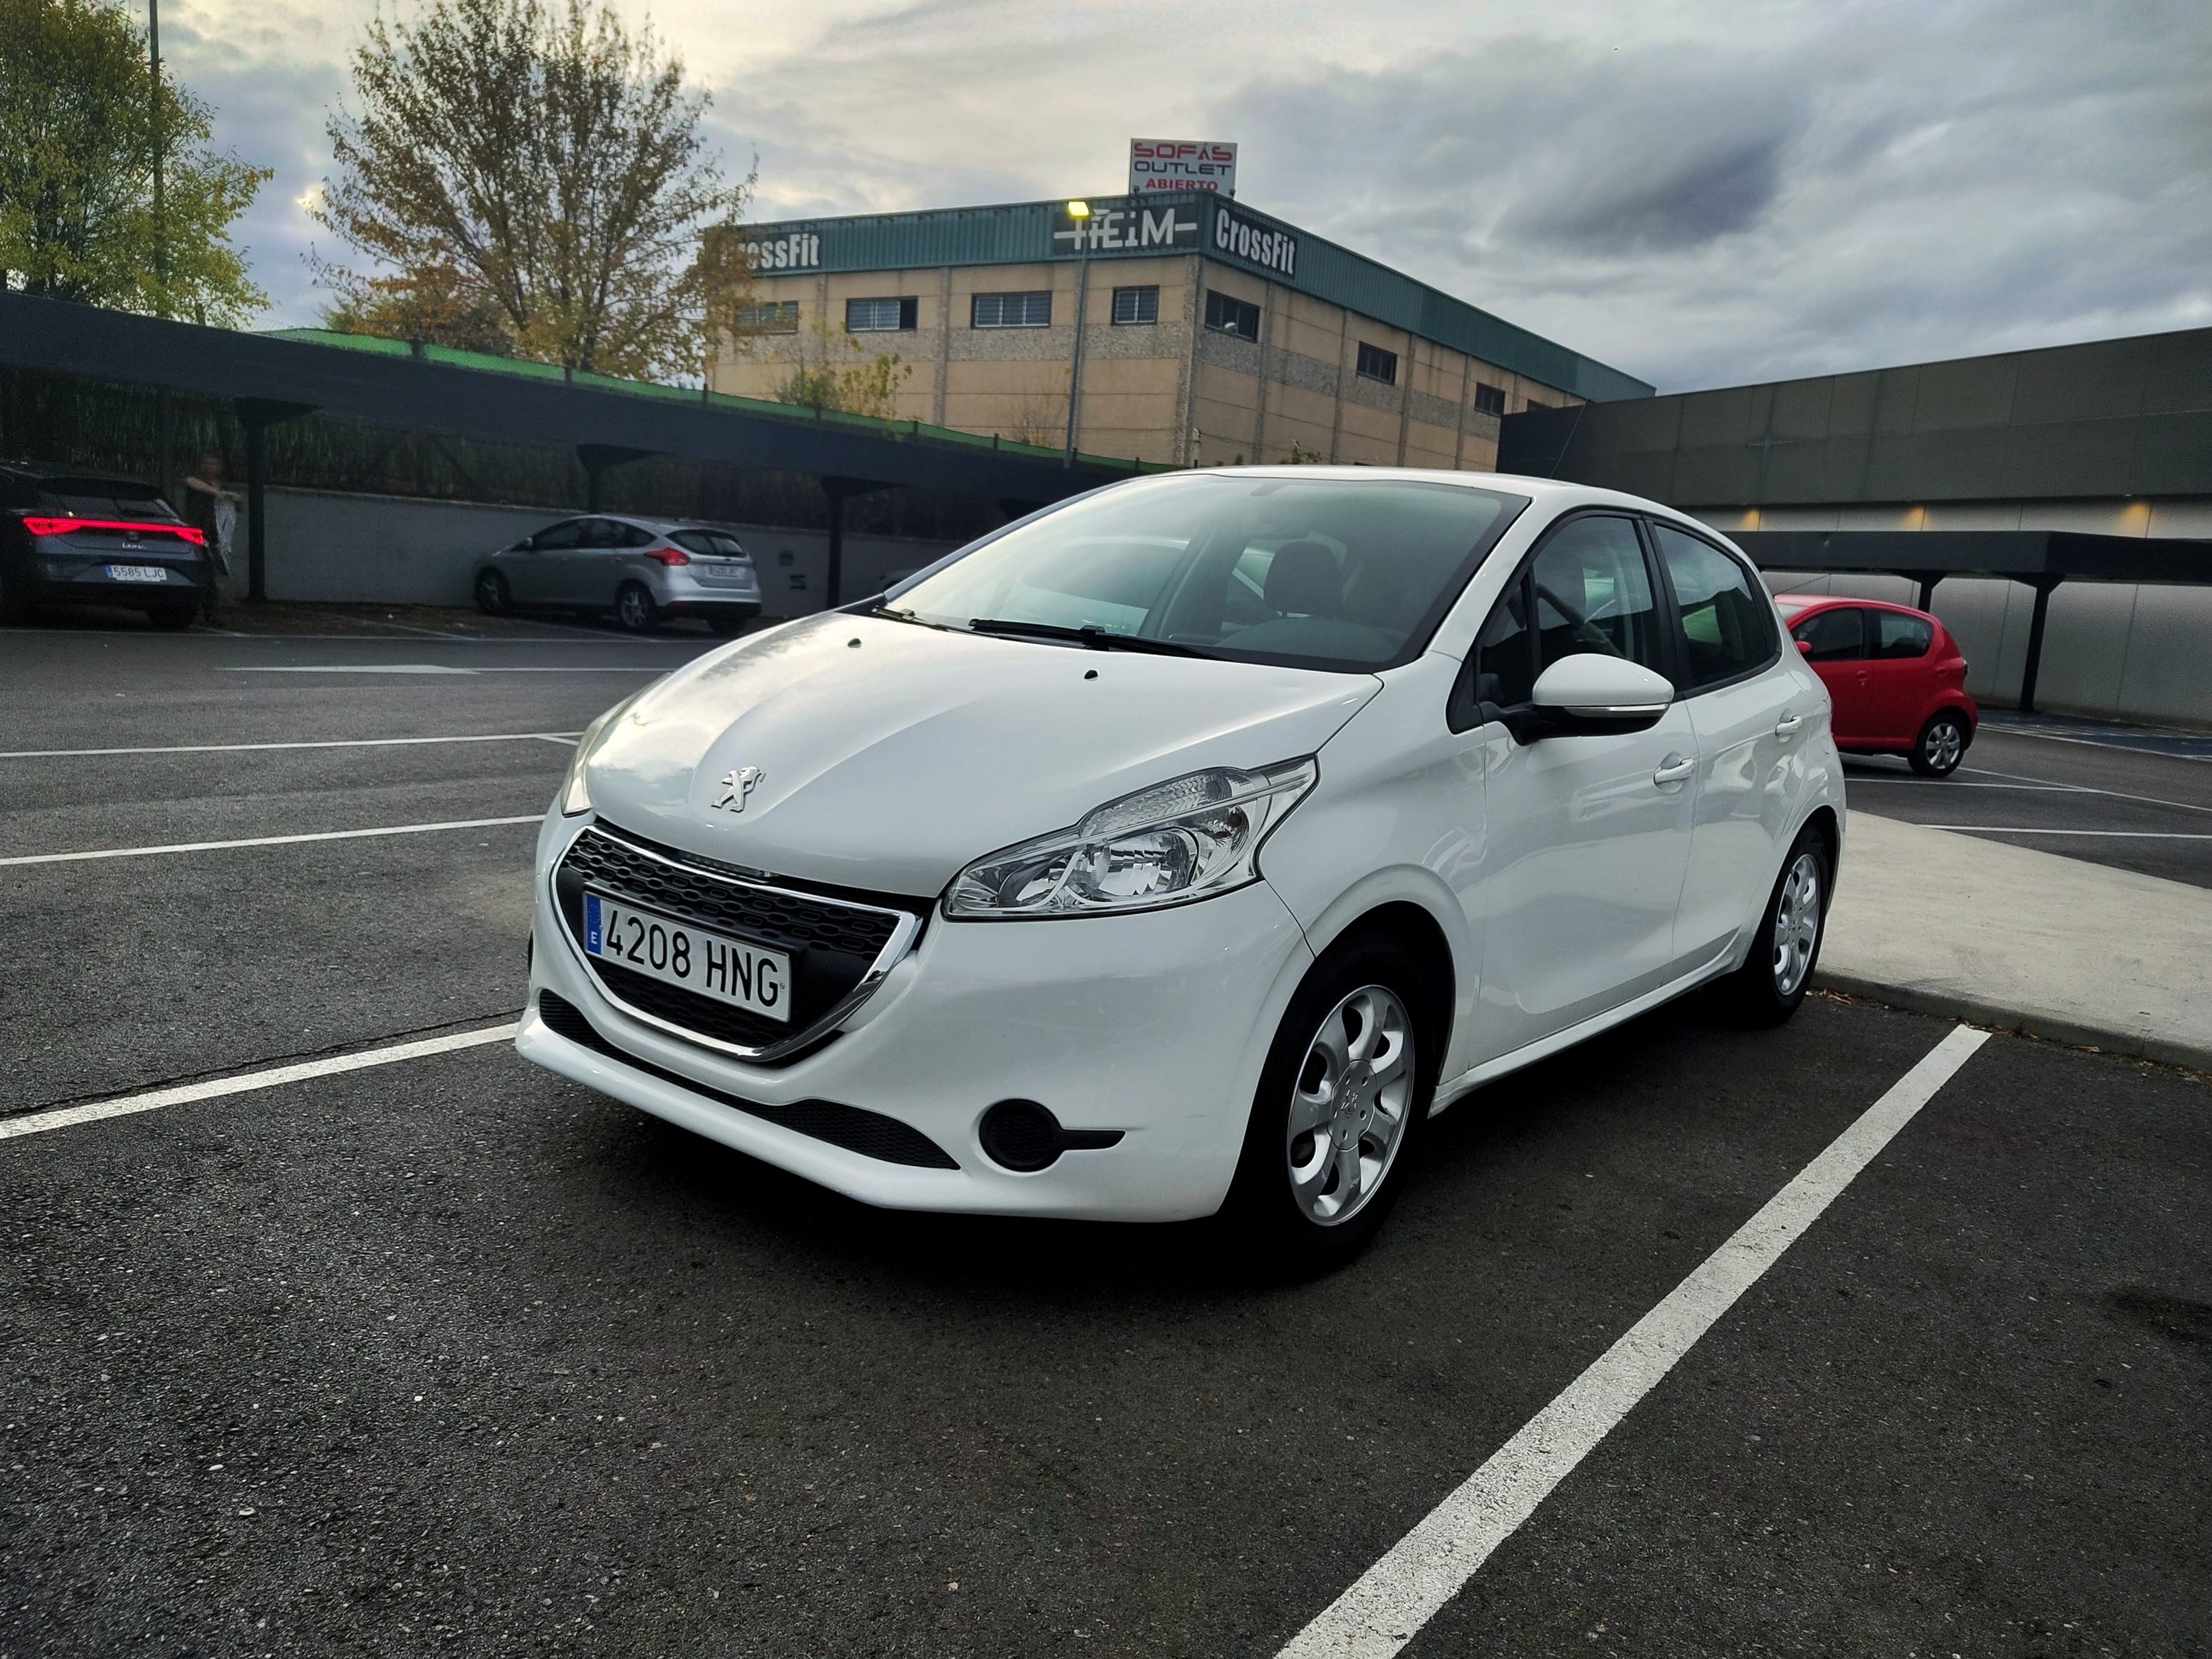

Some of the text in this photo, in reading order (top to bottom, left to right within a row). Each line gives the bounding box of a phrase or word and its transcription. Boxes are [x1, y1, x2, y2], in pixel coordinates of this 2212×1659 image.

[1134, 143, 1233, 161] SOFÁS
[1134, 160, 1232, 176] OUTLET
[1145, 178, 1219, 191] ABIERTO
[1216, 208, 1296, 275] CrossFit
[737, 233, 820, 269] ossFit
[590, 930, 598, 945] E
[606, 910, 779, 1007] 4208 HNG
